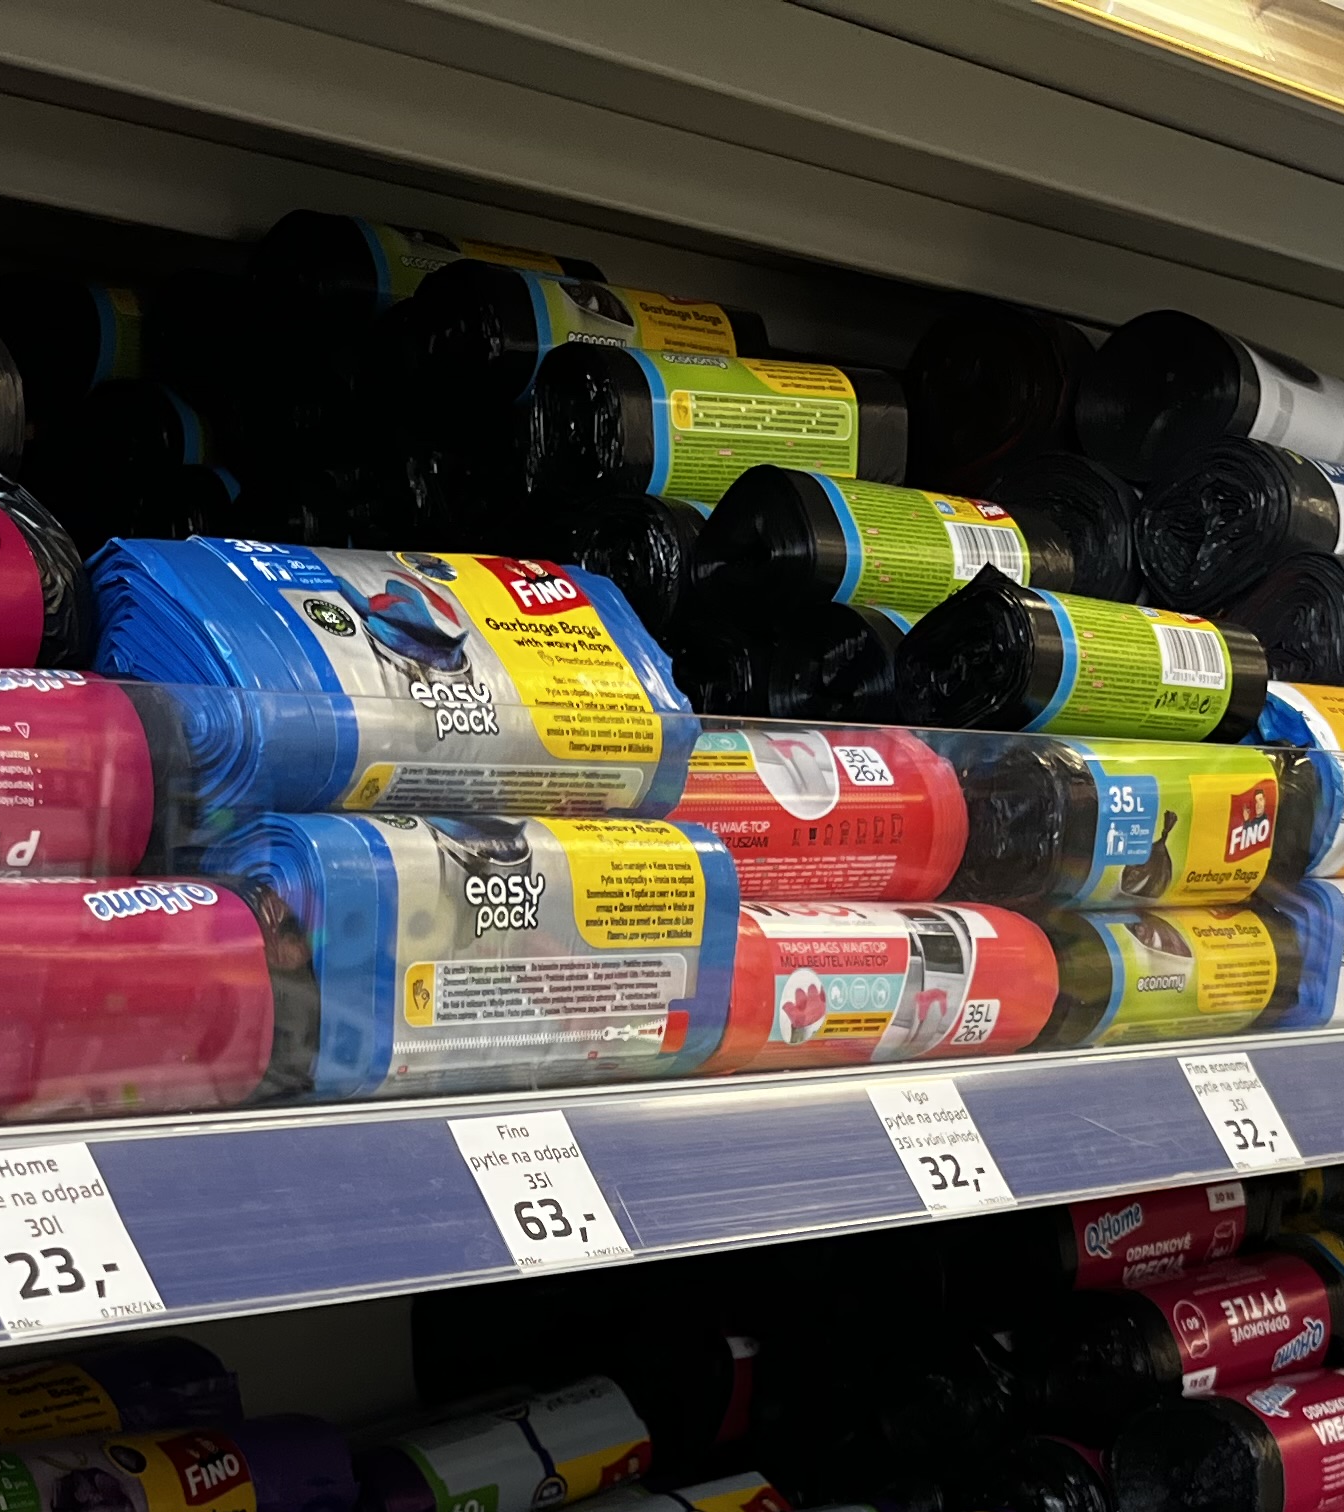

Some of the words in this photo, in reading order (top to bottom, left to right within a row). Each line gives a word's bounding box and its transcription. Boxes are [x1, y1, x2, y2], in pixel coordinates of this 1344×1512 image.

[510, 578, 577, 608] FINO
[485, 616, 558, 637] Garbage
[561, 621, 602, 638] Bags
[410, 680, 493, 709] easy
[436, 708, 499, 737] pack
[1229, 819, 1271, 856] FINO
[465, 873, 545, 902] easy
[1186, 869, 1230, 884] Garbage
[1232, 867, 1259, 882] Bags
[475, 902, 538, 935] pack
[814, 941, 839, 954] BAGS
[1137, 972, 1184, 992] economy
[902, 1090, 929, 1105] Vigo
[497, 1124, 530, 1141] Fino
[885, 1113, 914, 1130] pytle
[918, 1113, 932, 1123] na
[933, 1108, 968, 1124] odpad
[1224, 1119, 1277, 1152] 32,-
[469, 1151, 508, 1172] pytle
[512, 1150, 531, 1165] na
[534, 1142, 579, 1164] odpad
[524, 1171, 553, 1190] 35l
[918, 1154, 985, 1192] 32,-
[13, 1189, 38, 1208] na
[41, 1179, 104, 1208] odpad
[25, 1216, 64, 1239] 30l
[513, 1198, 596, 1244] 63,-
[5, 1248, 120, 1301] 23,-
[1221, 1288, 1287, 1326] PYTLE
[185, 1453, 242, 1498] FINO
